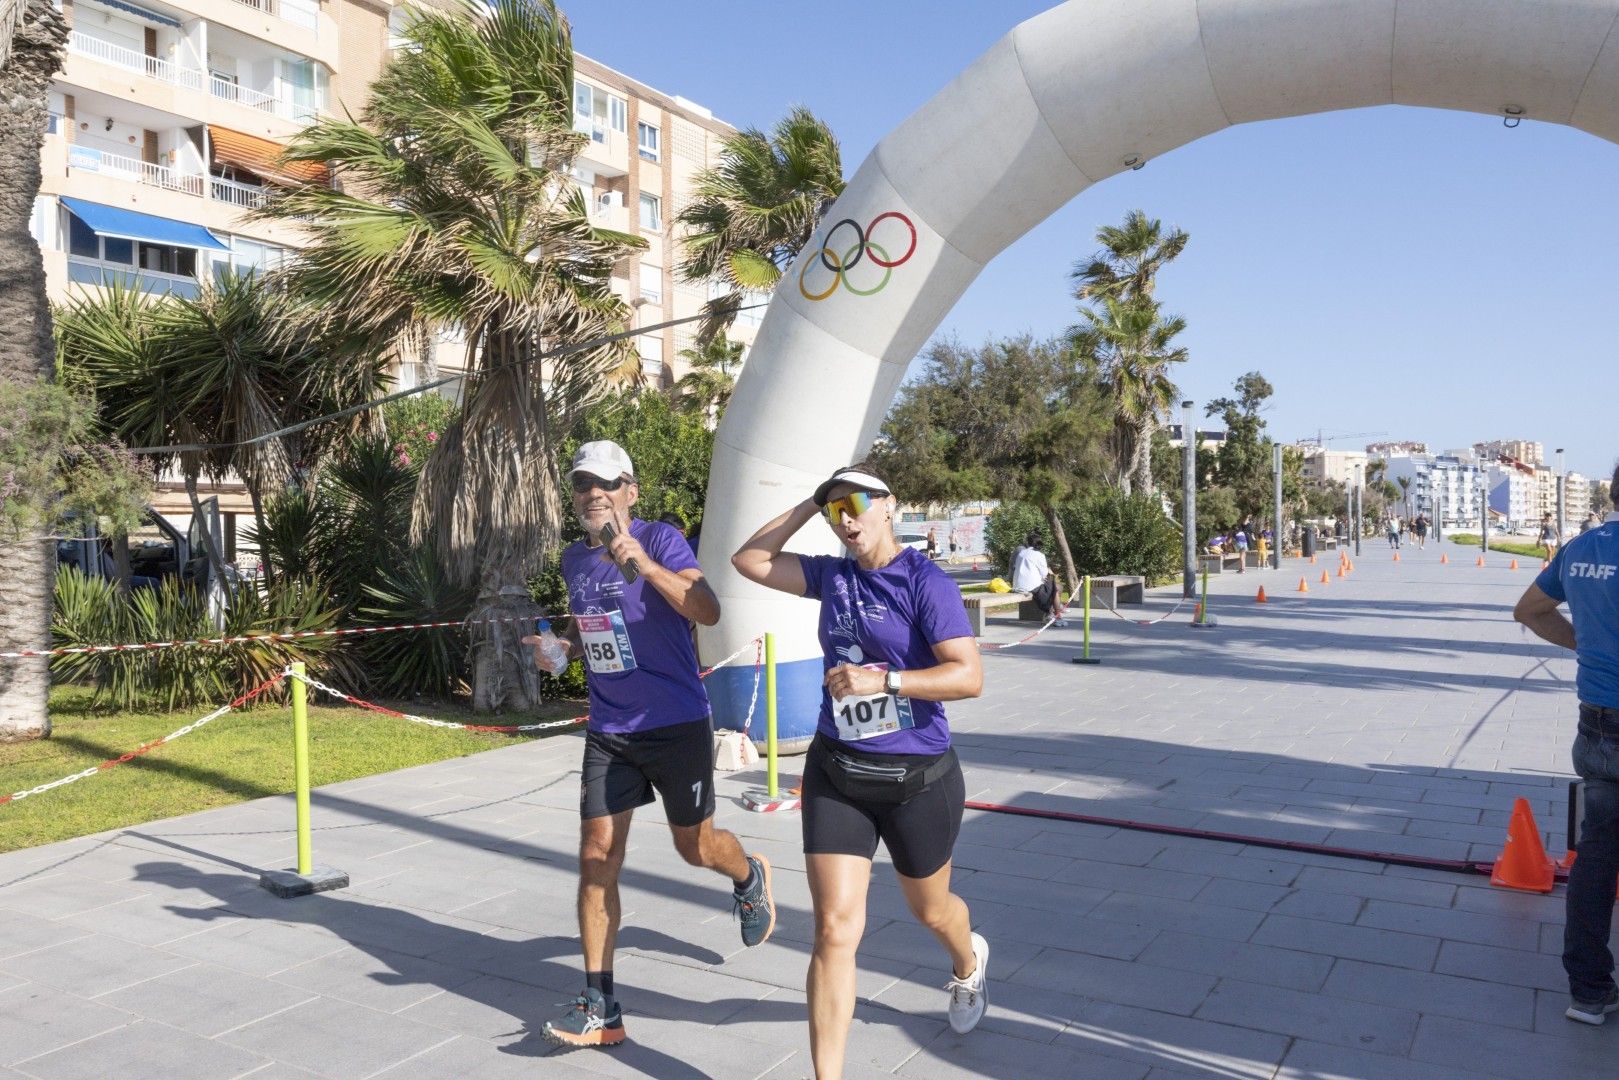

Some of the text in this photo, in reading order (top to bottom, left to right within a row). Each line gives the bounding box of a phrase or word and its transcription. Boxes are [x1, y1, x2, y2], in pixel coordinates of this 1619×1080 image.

[1570, 562, 1617, 580] STAFF
[584, 642, 616, 661] 158
[618, 634, 630, 651] KM
[841, 696, 889, 726] 107
